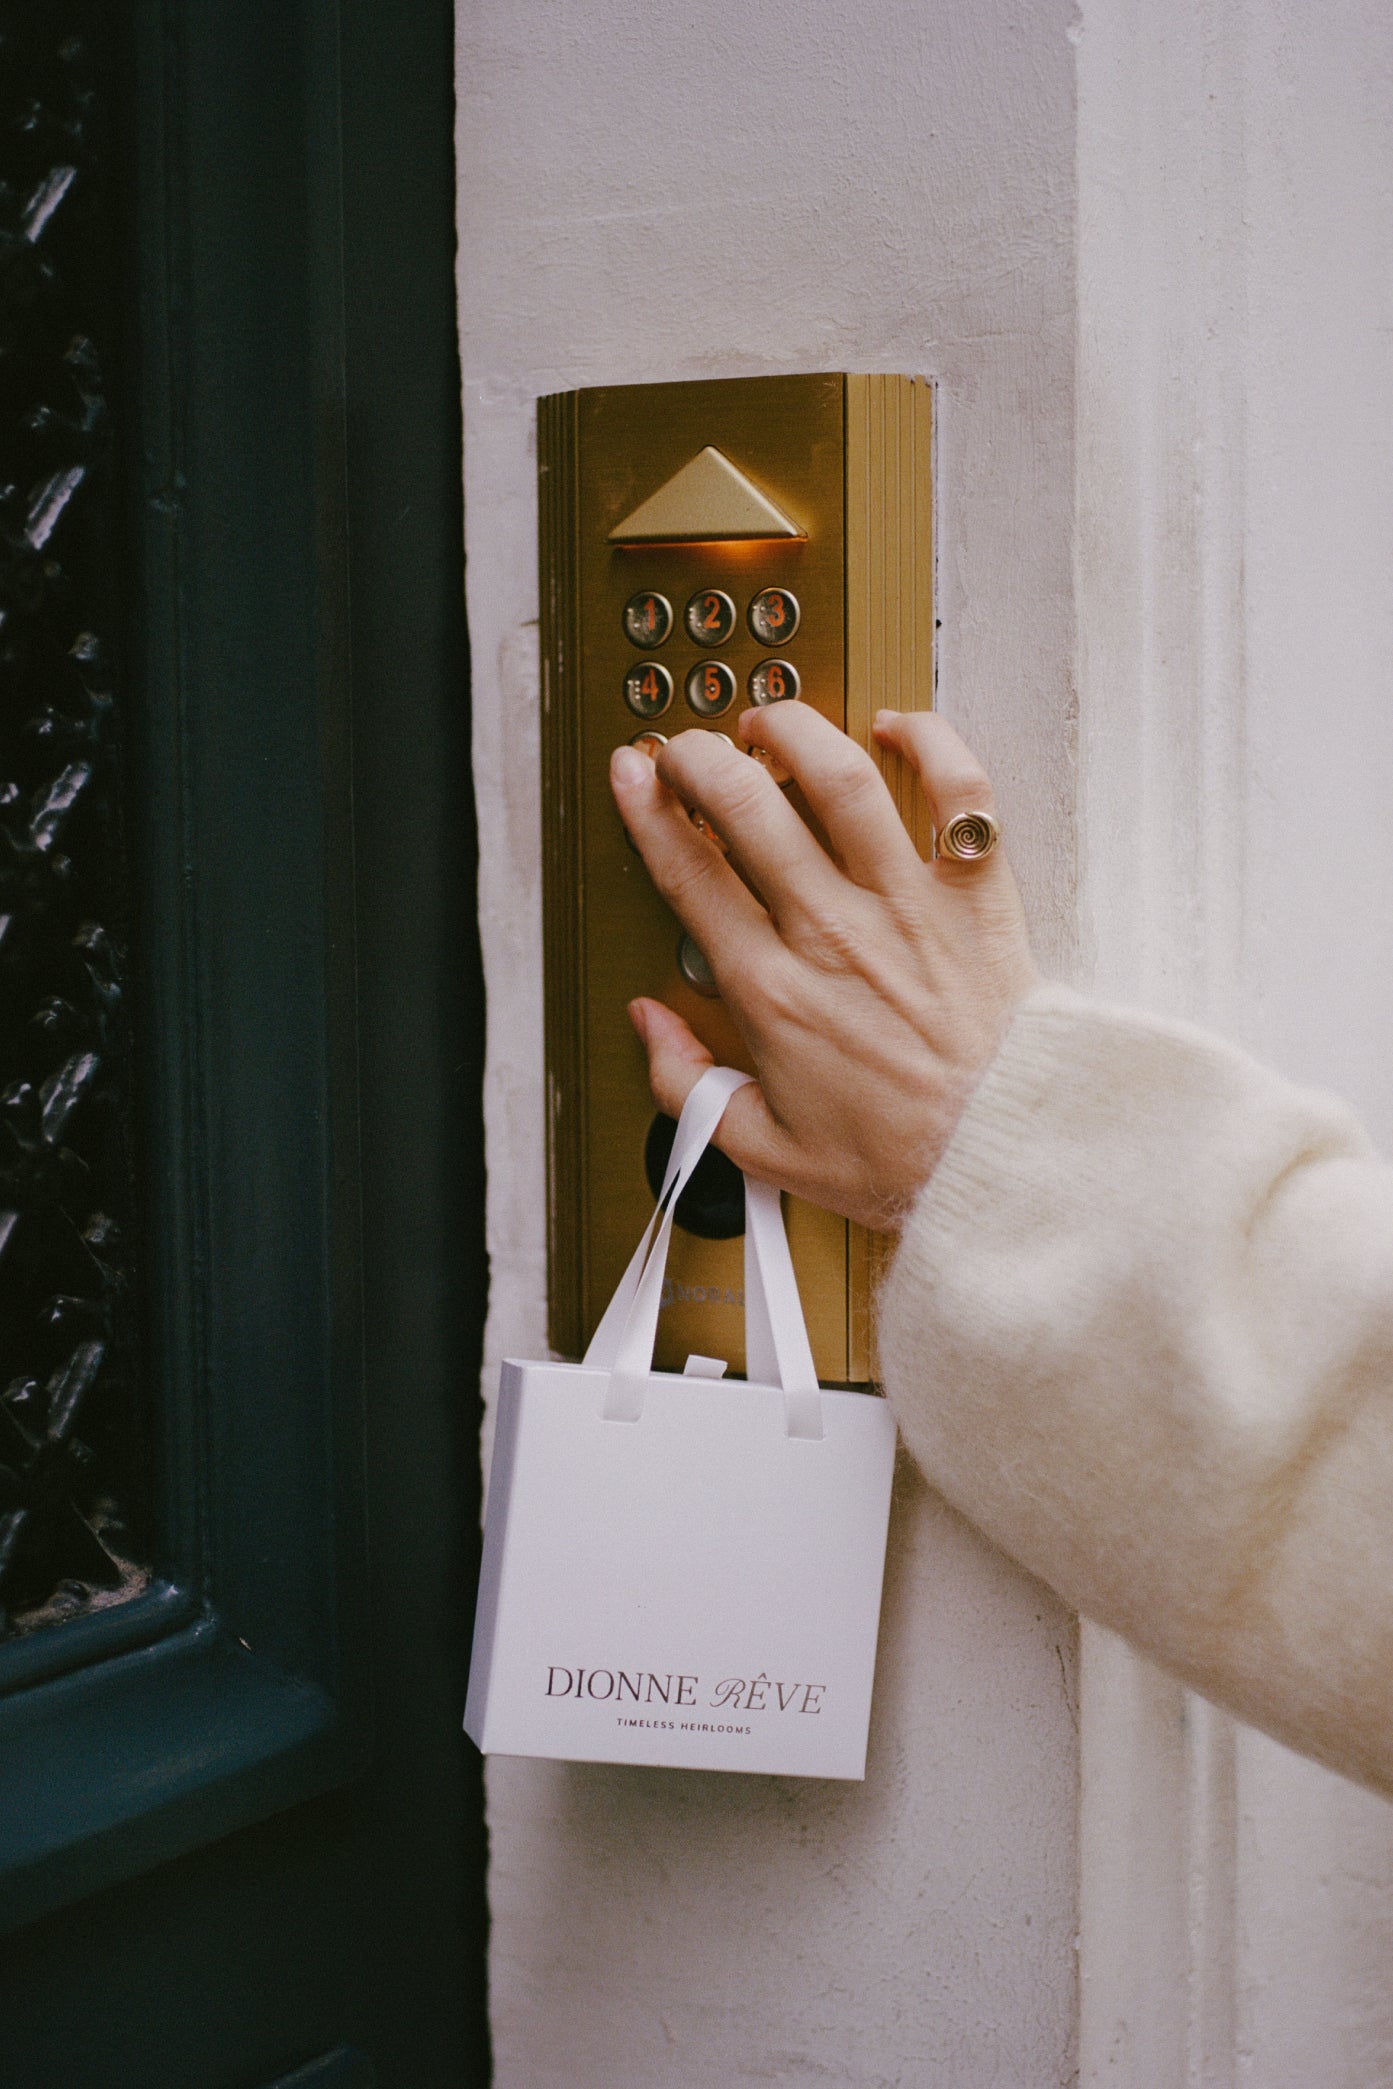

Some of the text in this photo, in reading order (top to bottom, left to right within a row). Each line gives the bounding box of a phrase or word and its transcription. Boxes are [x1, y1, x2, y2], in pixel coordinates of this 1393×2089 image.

[644, 594, 785, 631] 1 2 3
[641, 665, 785, 701] 4 5 6
[545, 1666, 826, 1714] DIONNE RÊVE
[617, 1718, 752, 1735] TIMELESS HEIRLOOMS
